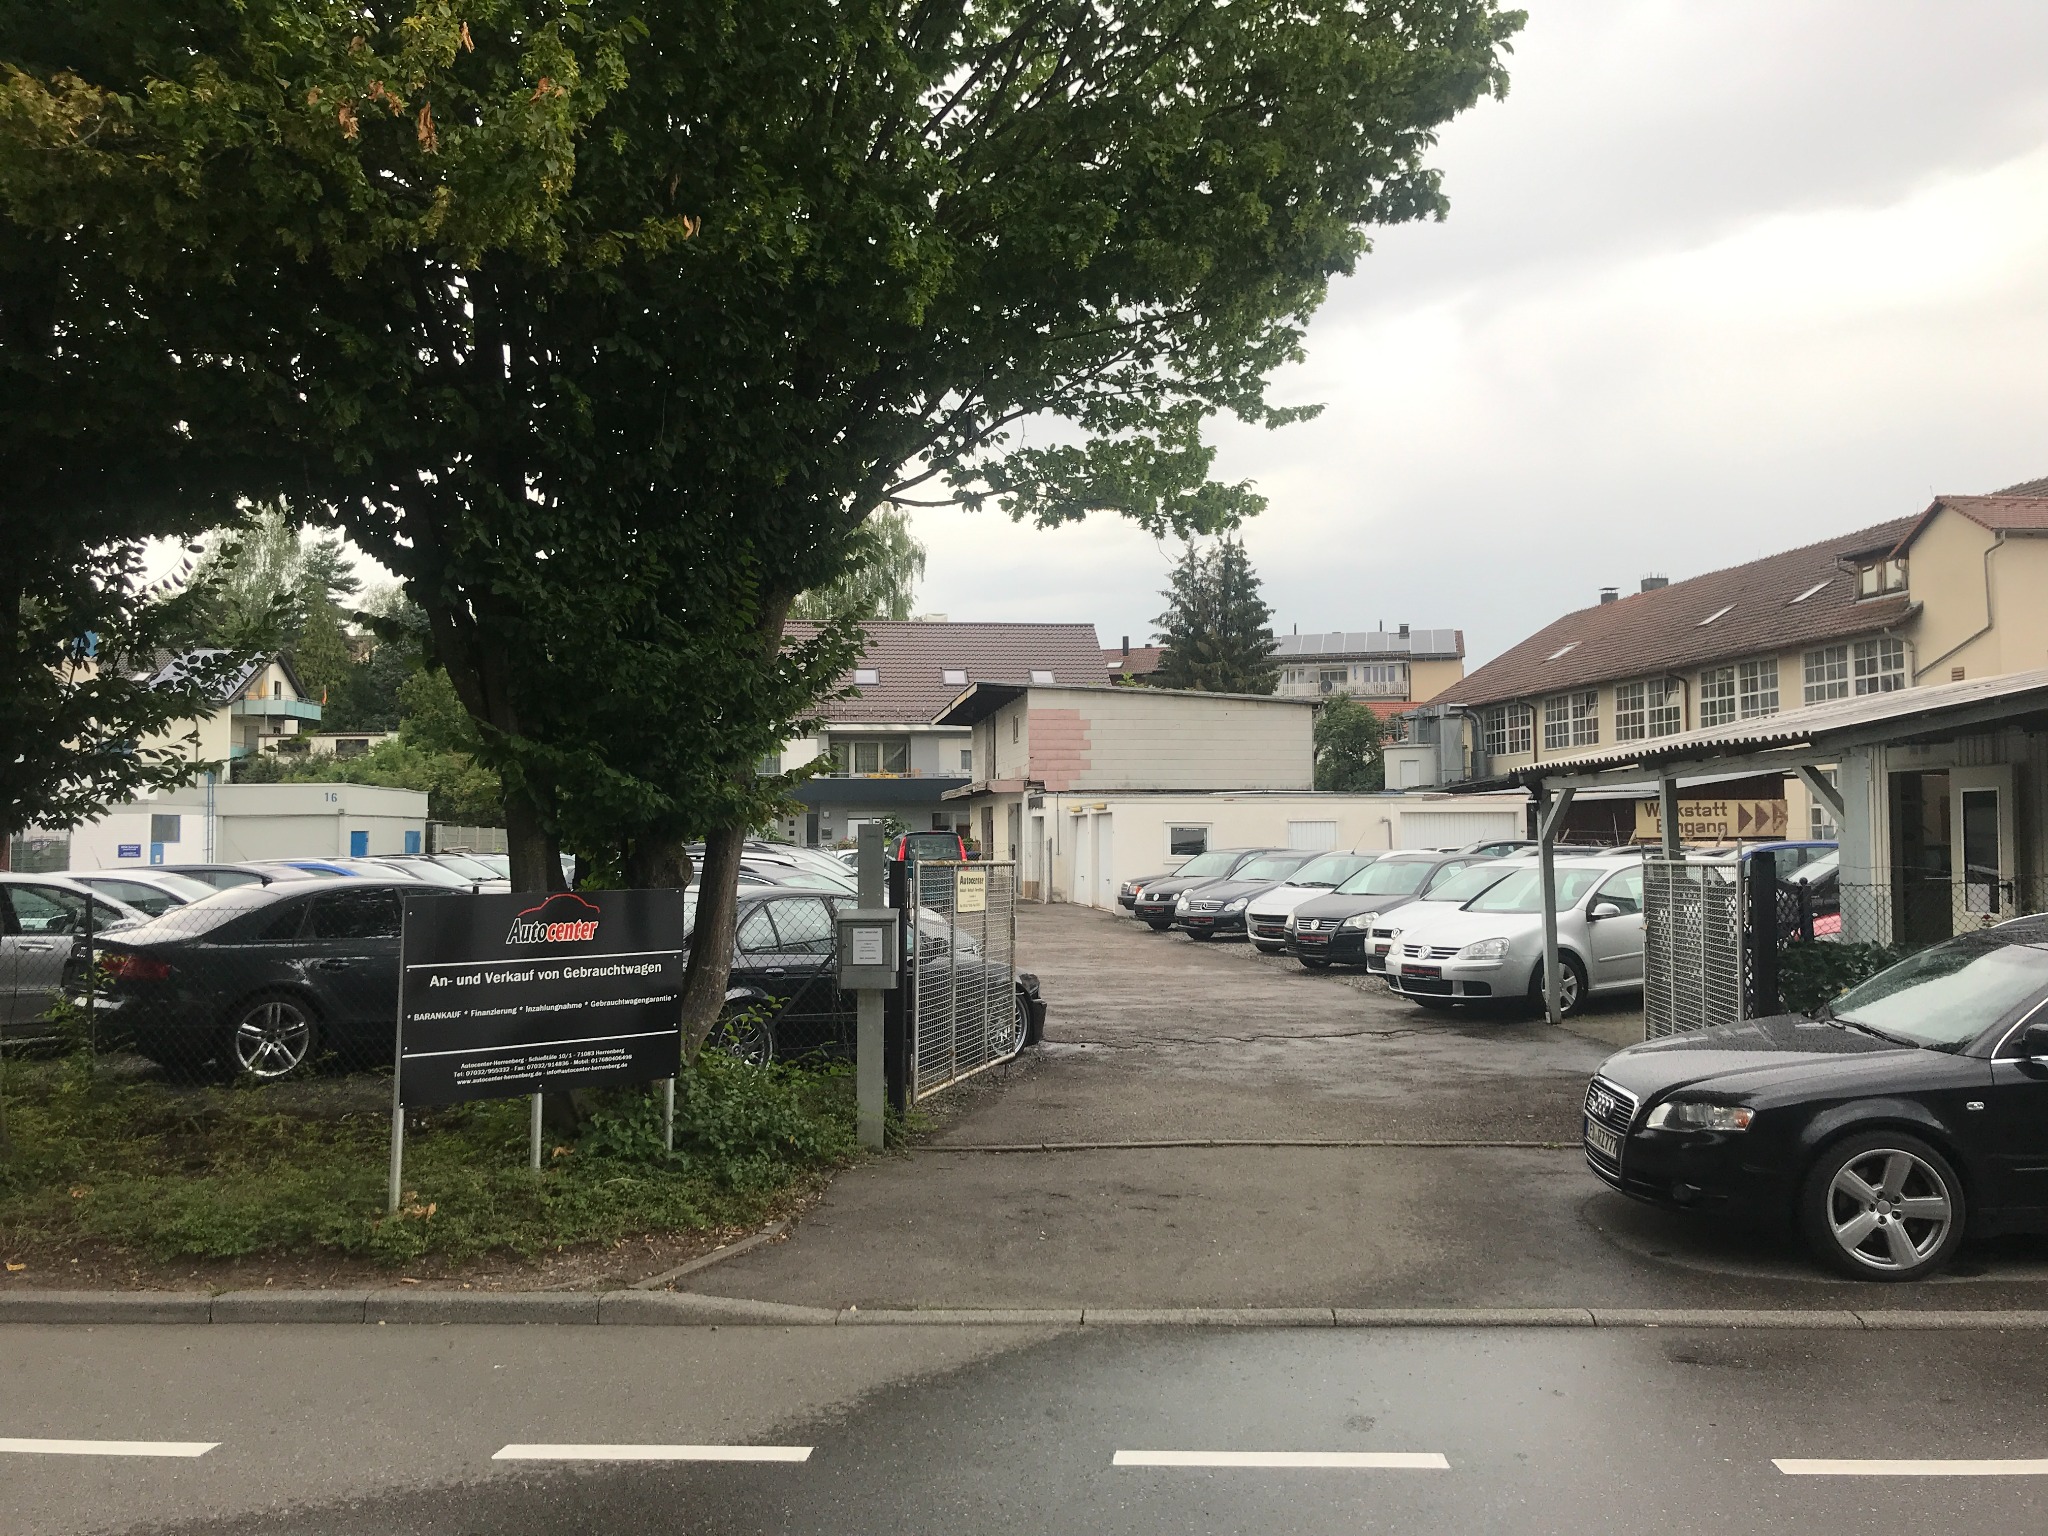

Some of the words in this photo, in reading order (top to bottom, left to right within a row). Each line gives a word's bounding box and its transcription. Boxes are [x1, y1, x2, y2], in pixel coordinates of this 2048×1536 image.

[325, 792, 337, 802] 16
[1644, 802, 1728, 817] Wkstatt
[506, 917, 599, 944] Autocenter
[430, 975, 453, 987] An-
[456, 971, 481, 986] und
[485, 968, 535, 984] Verkauf
[538, 969, 560, 981] von
[563, 961, 662, 980] Gebrauchtwagen
[414, 1010, 462, 1021] BARANKAUF
[471, 1006, 517, 1017] Finanzierung
[525, 1001, 583, 1012] Inzahlungnahme
[590, 994, 671, 1007] Gebrauchtwagengarantie
